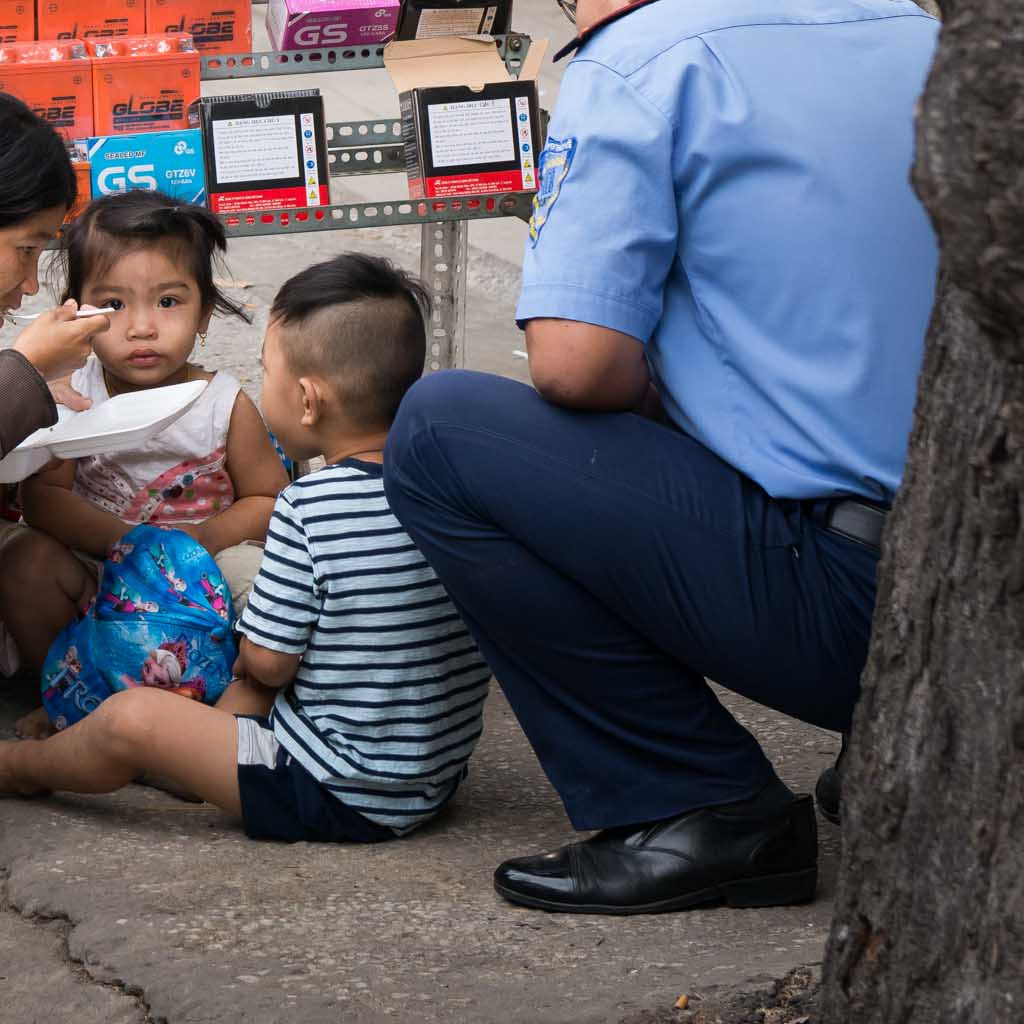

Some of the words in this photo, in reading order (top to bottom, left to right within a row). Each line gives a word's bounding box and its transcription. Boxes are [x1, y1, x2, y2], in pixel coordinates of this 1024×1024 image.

[294, 23, 348, 46] GS
[112, 95, 185, 116] GLOBE
[97, 163, 157, 196] GS
